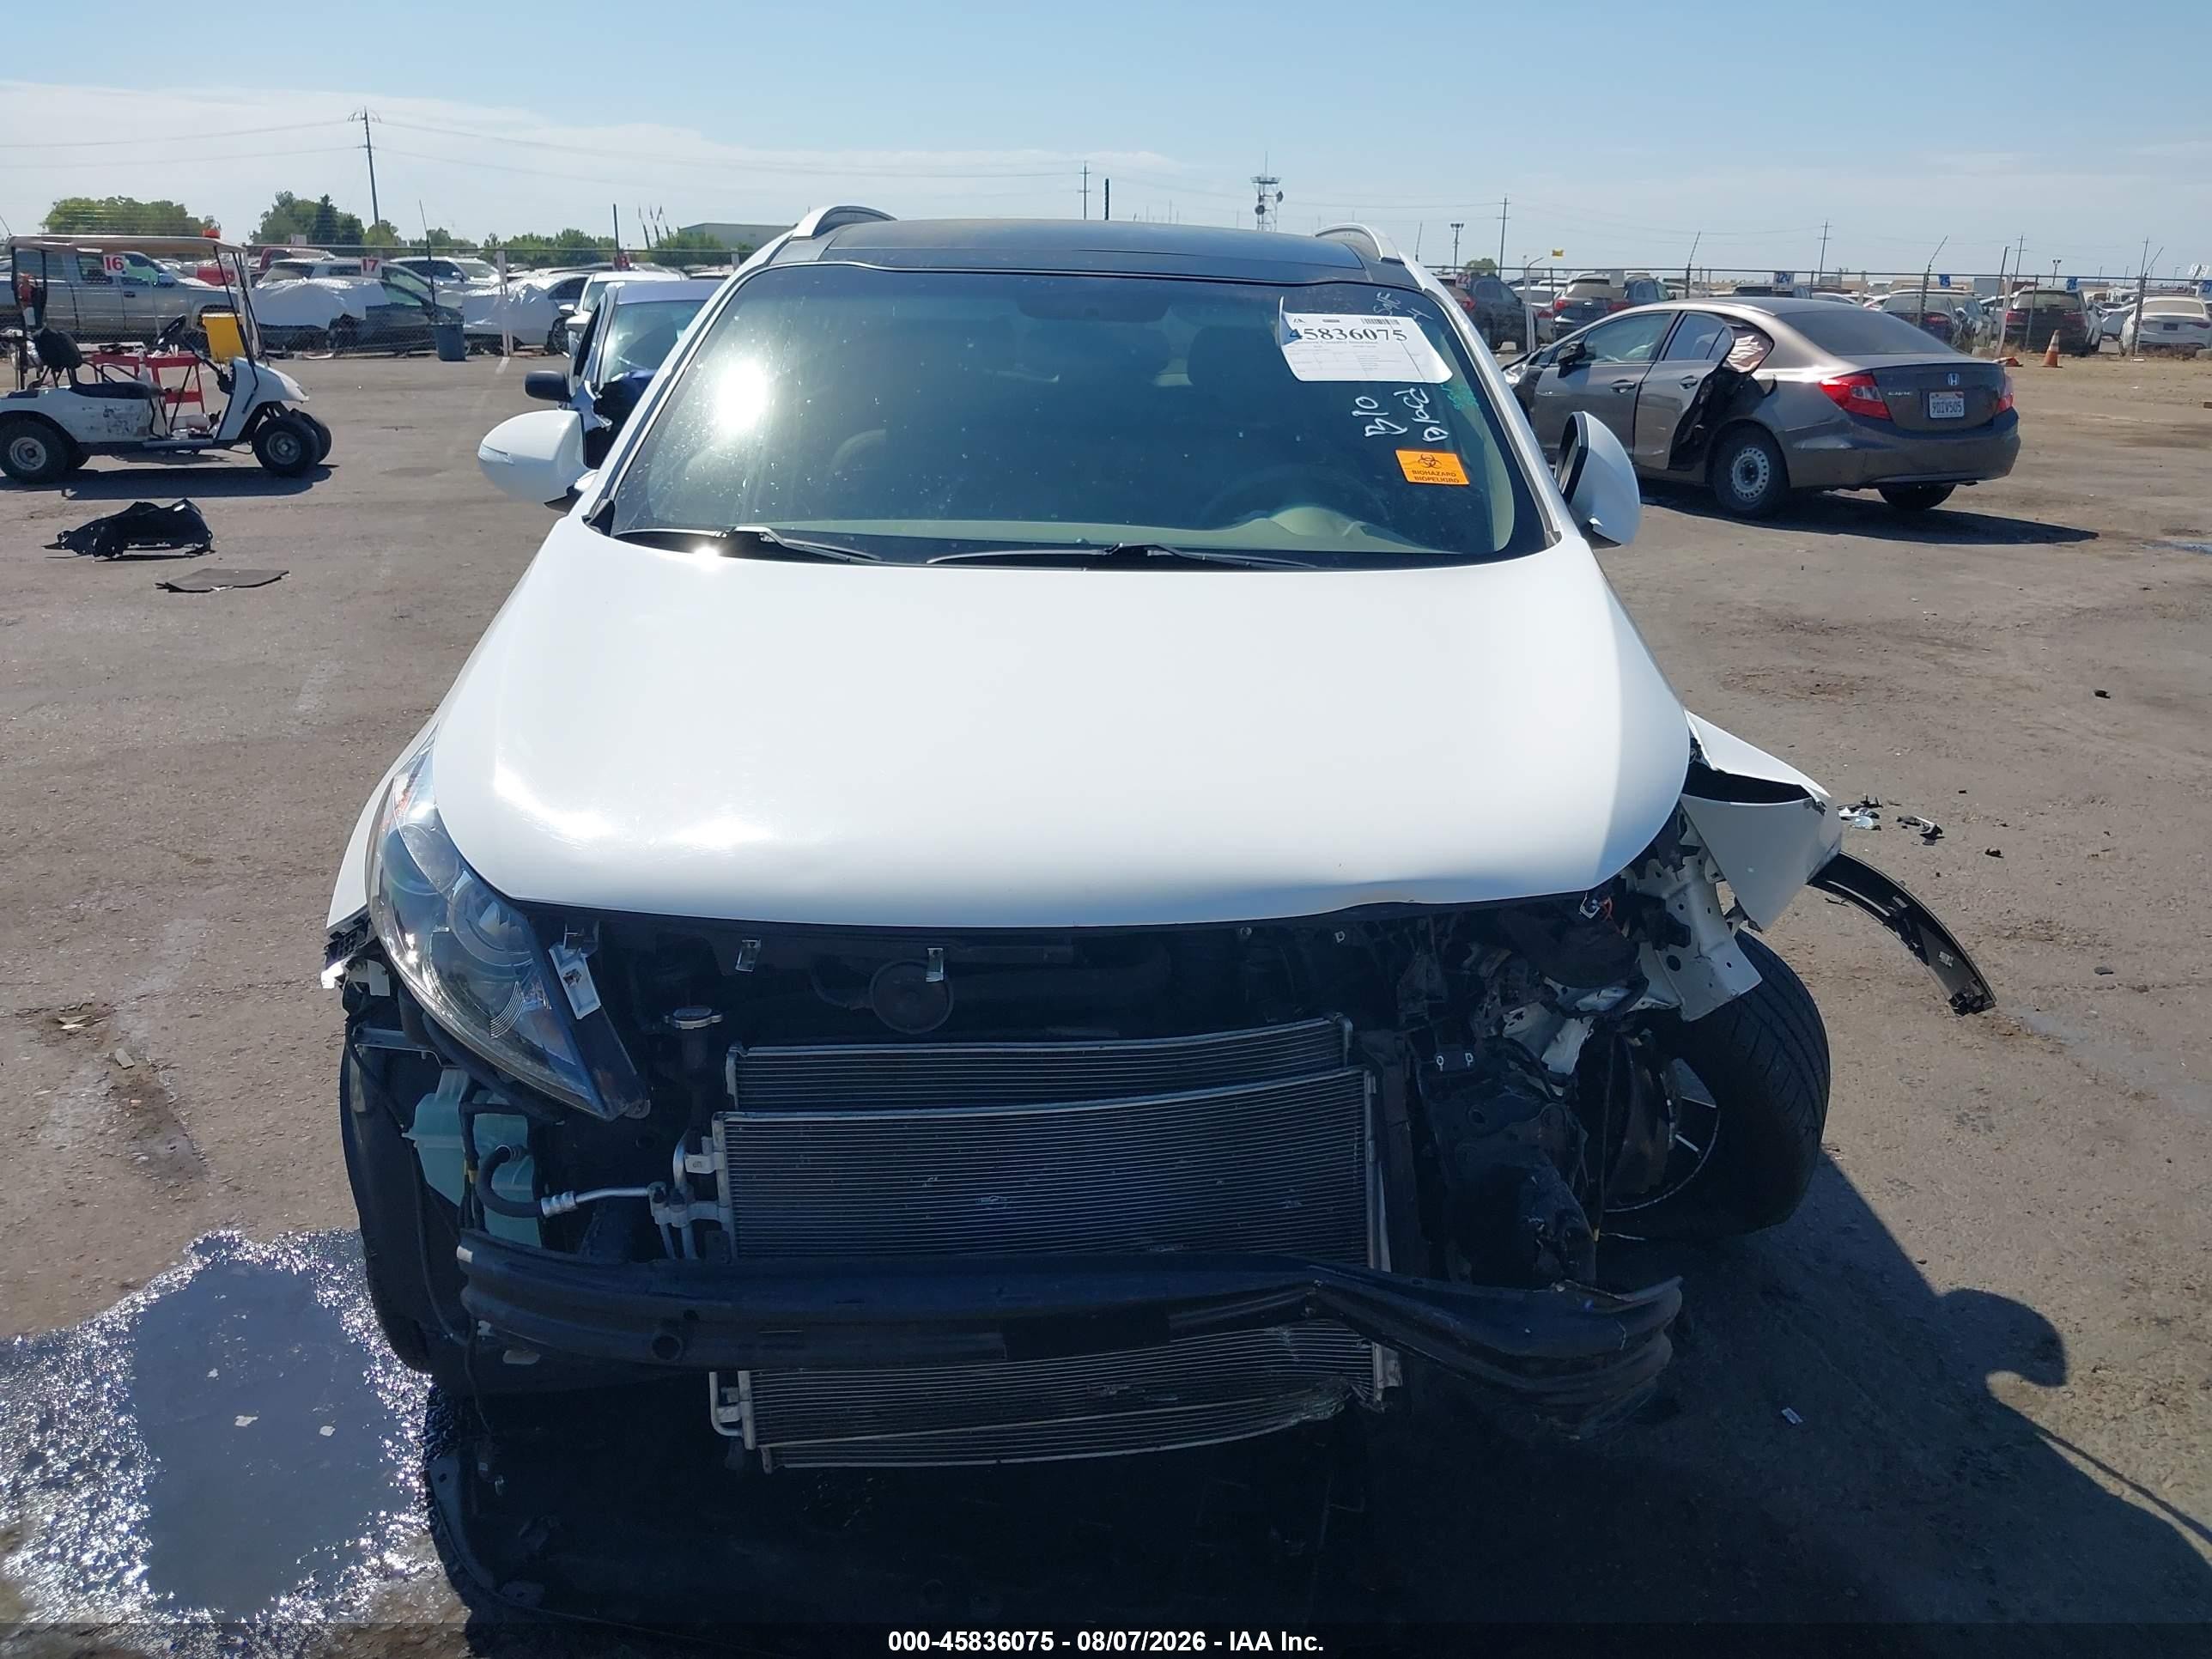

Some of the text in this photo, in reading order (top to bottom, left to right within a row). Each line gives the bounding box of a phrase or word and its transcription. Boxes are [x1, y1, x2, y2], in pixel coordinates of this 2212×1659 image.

[104, 256, 125, 271] 16
[362, 258, 380, 272] 17
[1456, 273, 1471, 284] 22
[1290, 327, 1408, 343] 45836075
[1412, 469, 1457, 477] BIOHAZARD
